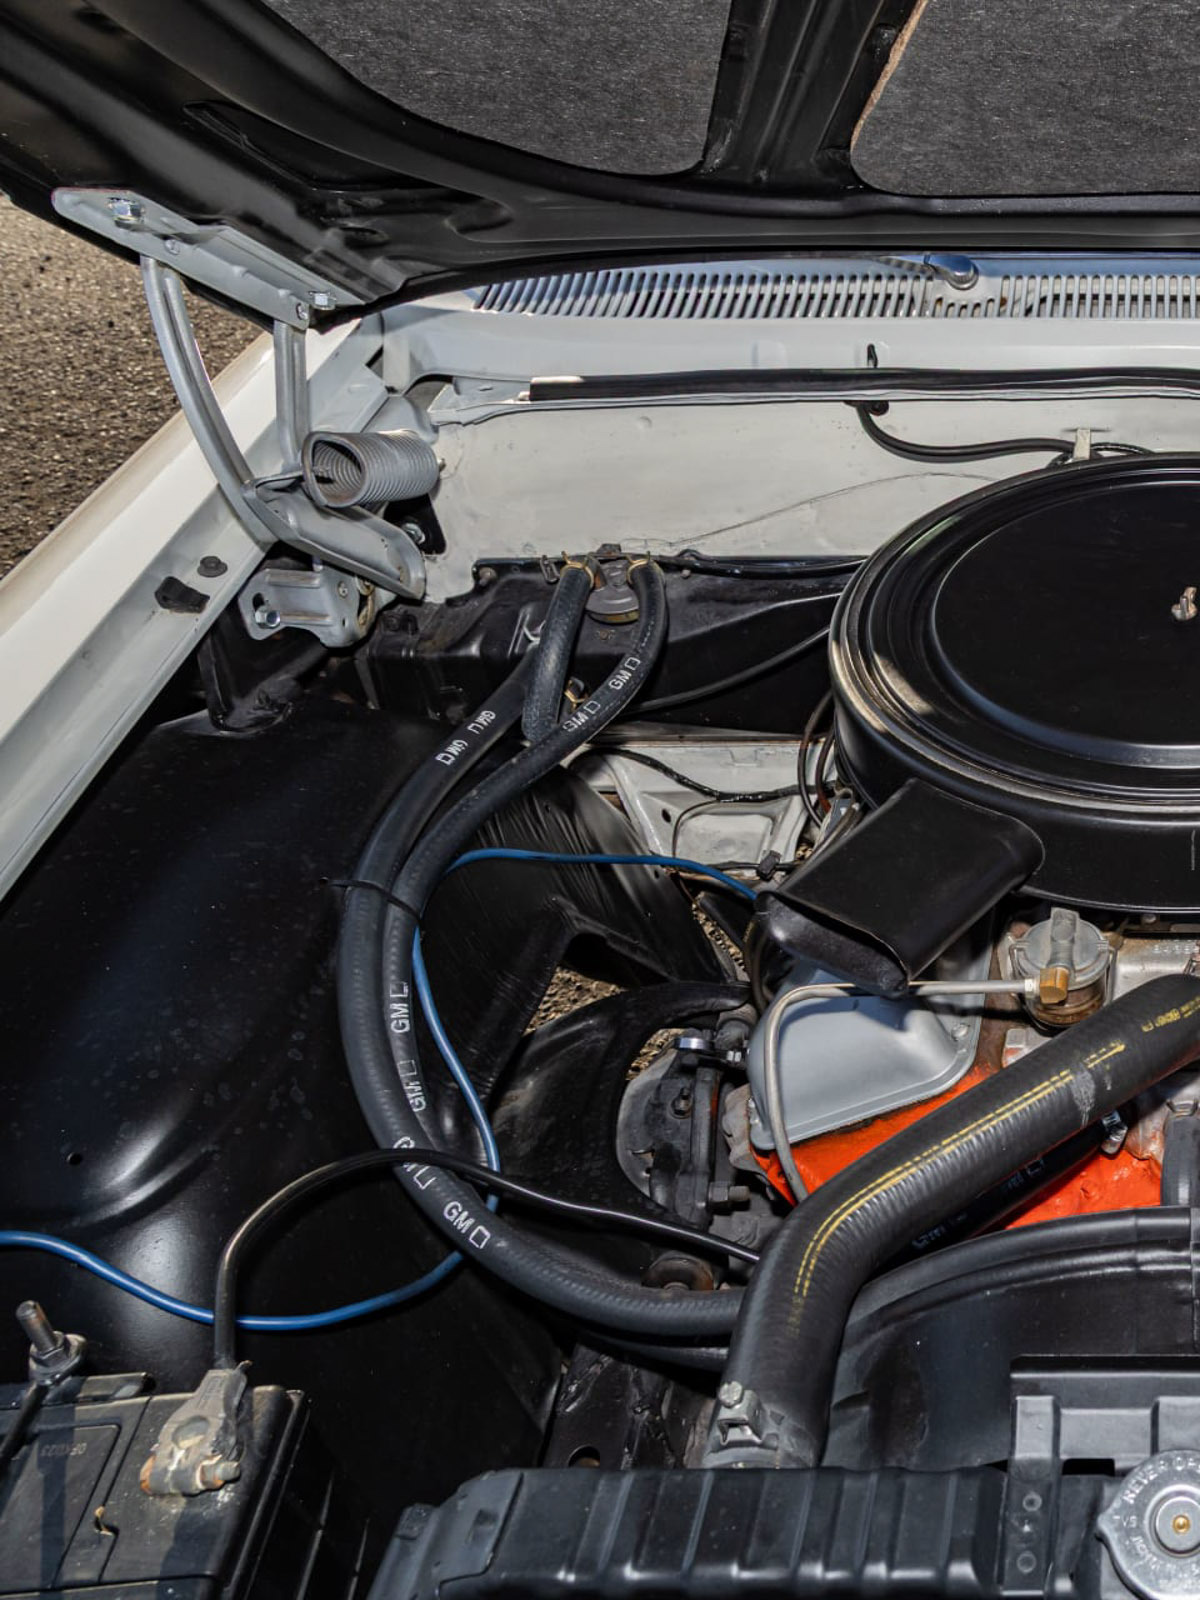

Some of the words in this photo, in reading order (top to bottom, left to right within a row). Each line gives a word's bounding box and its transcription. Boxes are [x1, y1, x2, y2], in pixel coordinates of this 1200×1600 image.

[391, 1002, 410, 1034] GM
[443, 1200, 475, 1234] GM
[1122, 1460, 1168, 1504] NEVER
